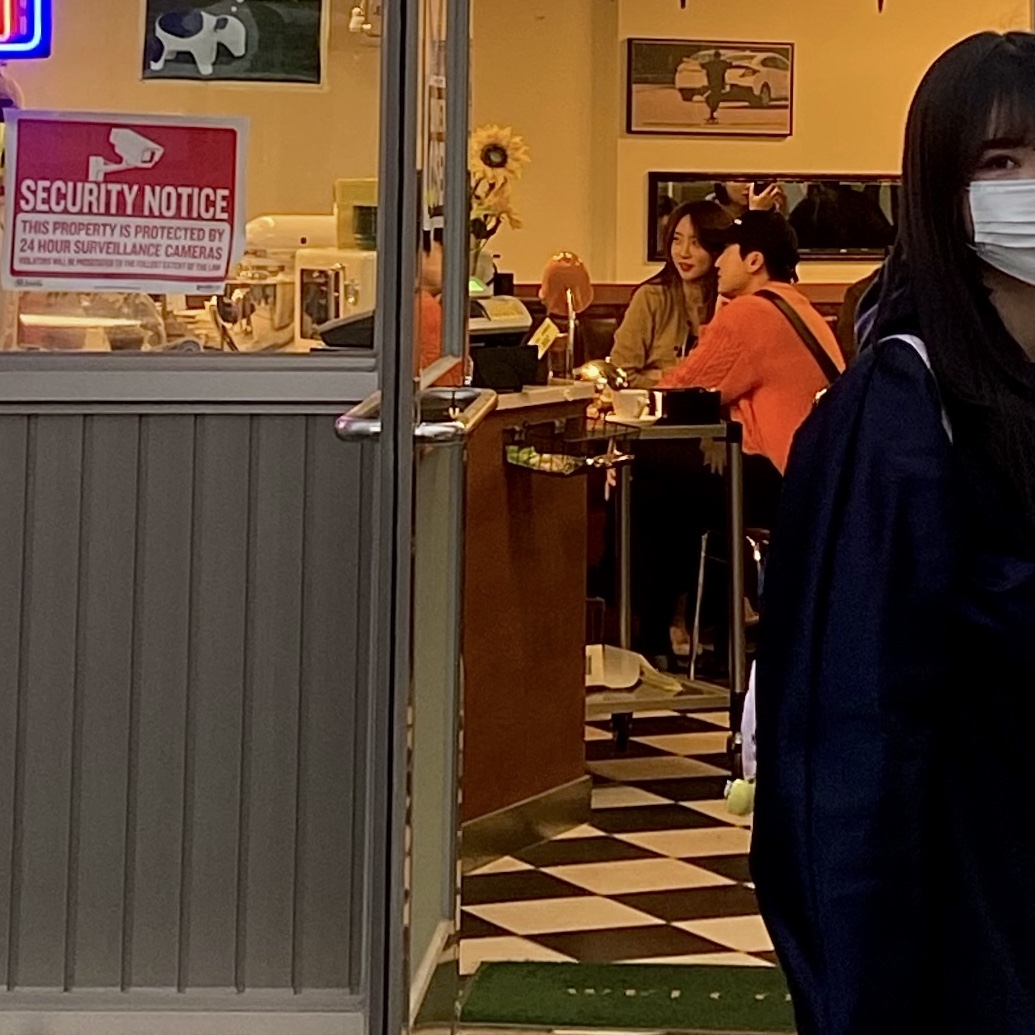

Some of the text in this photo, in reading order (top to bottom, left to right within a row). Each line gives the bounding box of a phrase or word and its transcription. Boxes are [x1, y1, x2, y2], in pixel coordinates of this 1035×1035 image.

[20, 179, 230, 220] SECURITY NOTICE
[20, 220, 226, 243] THIS PROPERTY IS PROTECTED BY
[19, 238, 223, 261] 24 HOUR SURVEILLANCE CAMERAS
